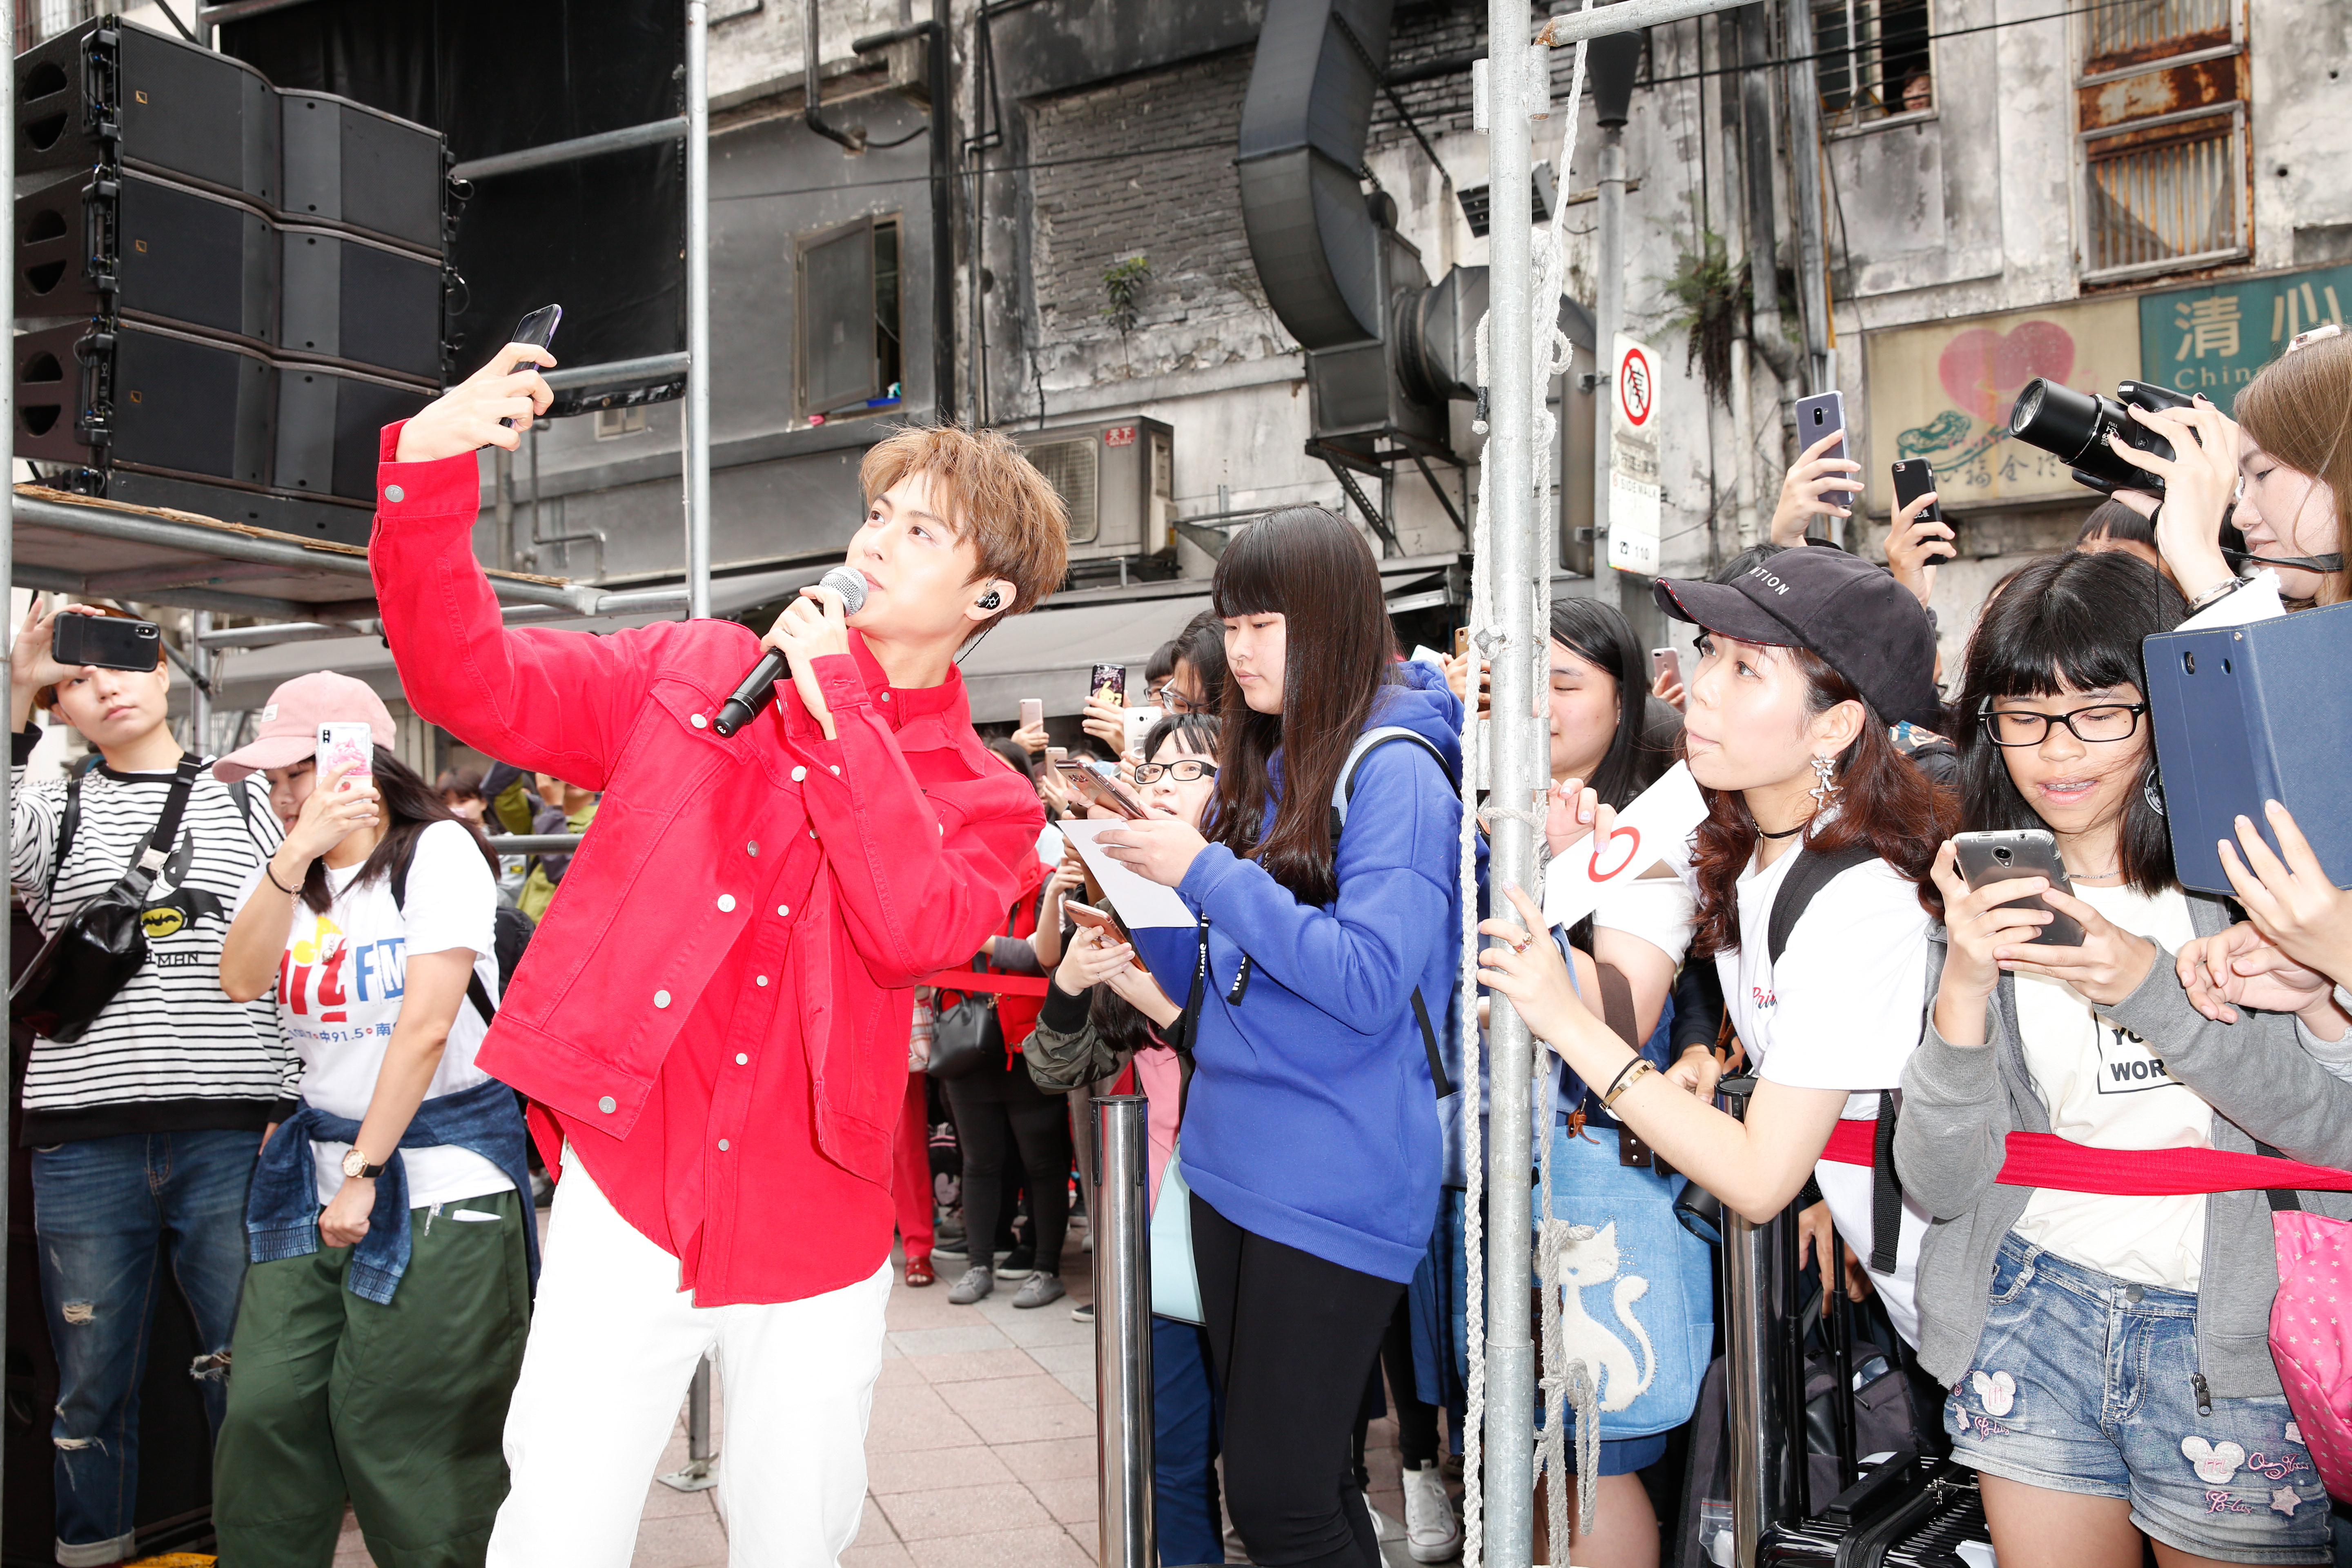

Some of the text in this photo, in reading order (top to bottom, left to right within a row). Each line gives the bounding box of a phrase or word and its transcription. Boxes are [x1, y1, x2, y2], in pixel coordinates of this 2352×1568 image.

[2174, 365, 2260, 390] Chin
[1635, 546, 1650, 560] 110
[1748, 566, 1790, 595] NTION
[375, 1022, 397, 1037] 南
[2111, 1027, 2144, 1045] YO
[2110, 1059, 2167, 1081] WOR
